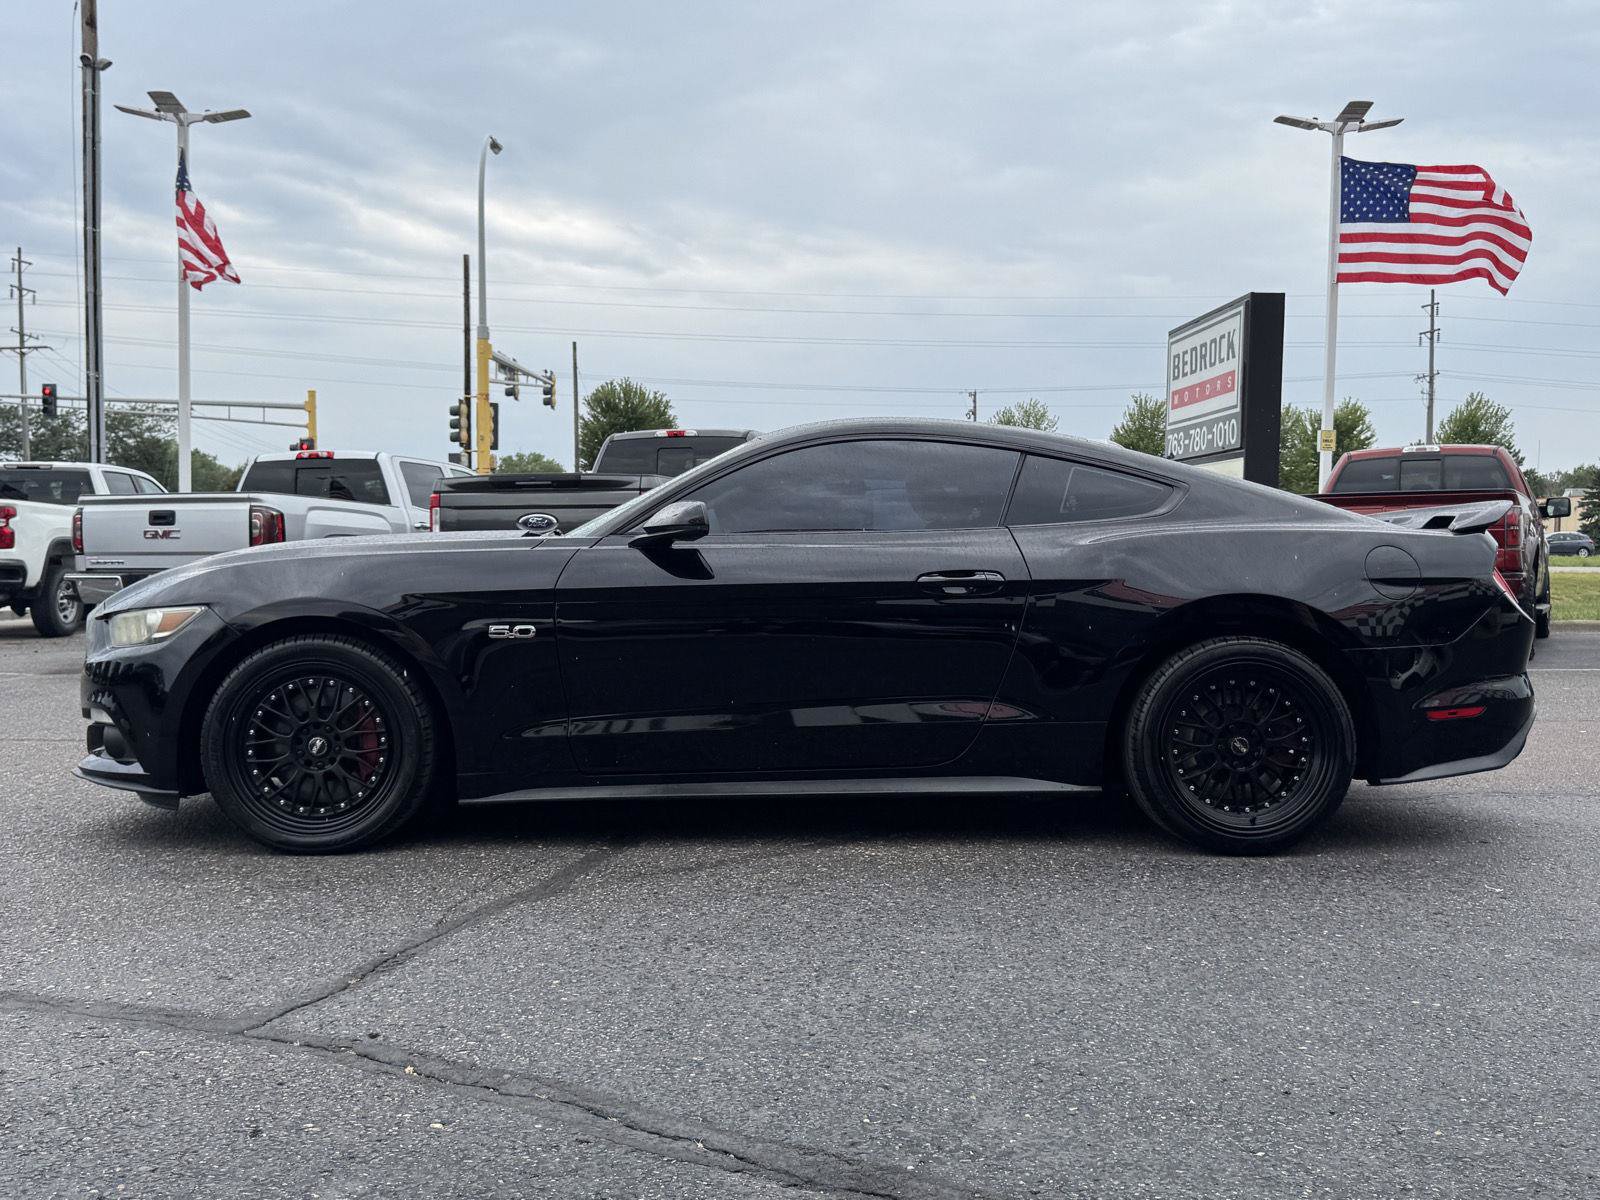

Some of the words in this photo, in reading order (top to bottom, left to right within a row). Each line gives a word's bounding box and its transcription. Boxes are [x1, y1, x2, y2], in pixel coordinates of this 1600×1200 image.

[1172, 329, 1236, 381] BEDROCK
[1173, 375, 1232, 405] MOTORS
[1167, 419, 1237, 456] 763-780-1010
[143, 529, 181, 540] GMC
[488, 625, 536, 639] 5.0
